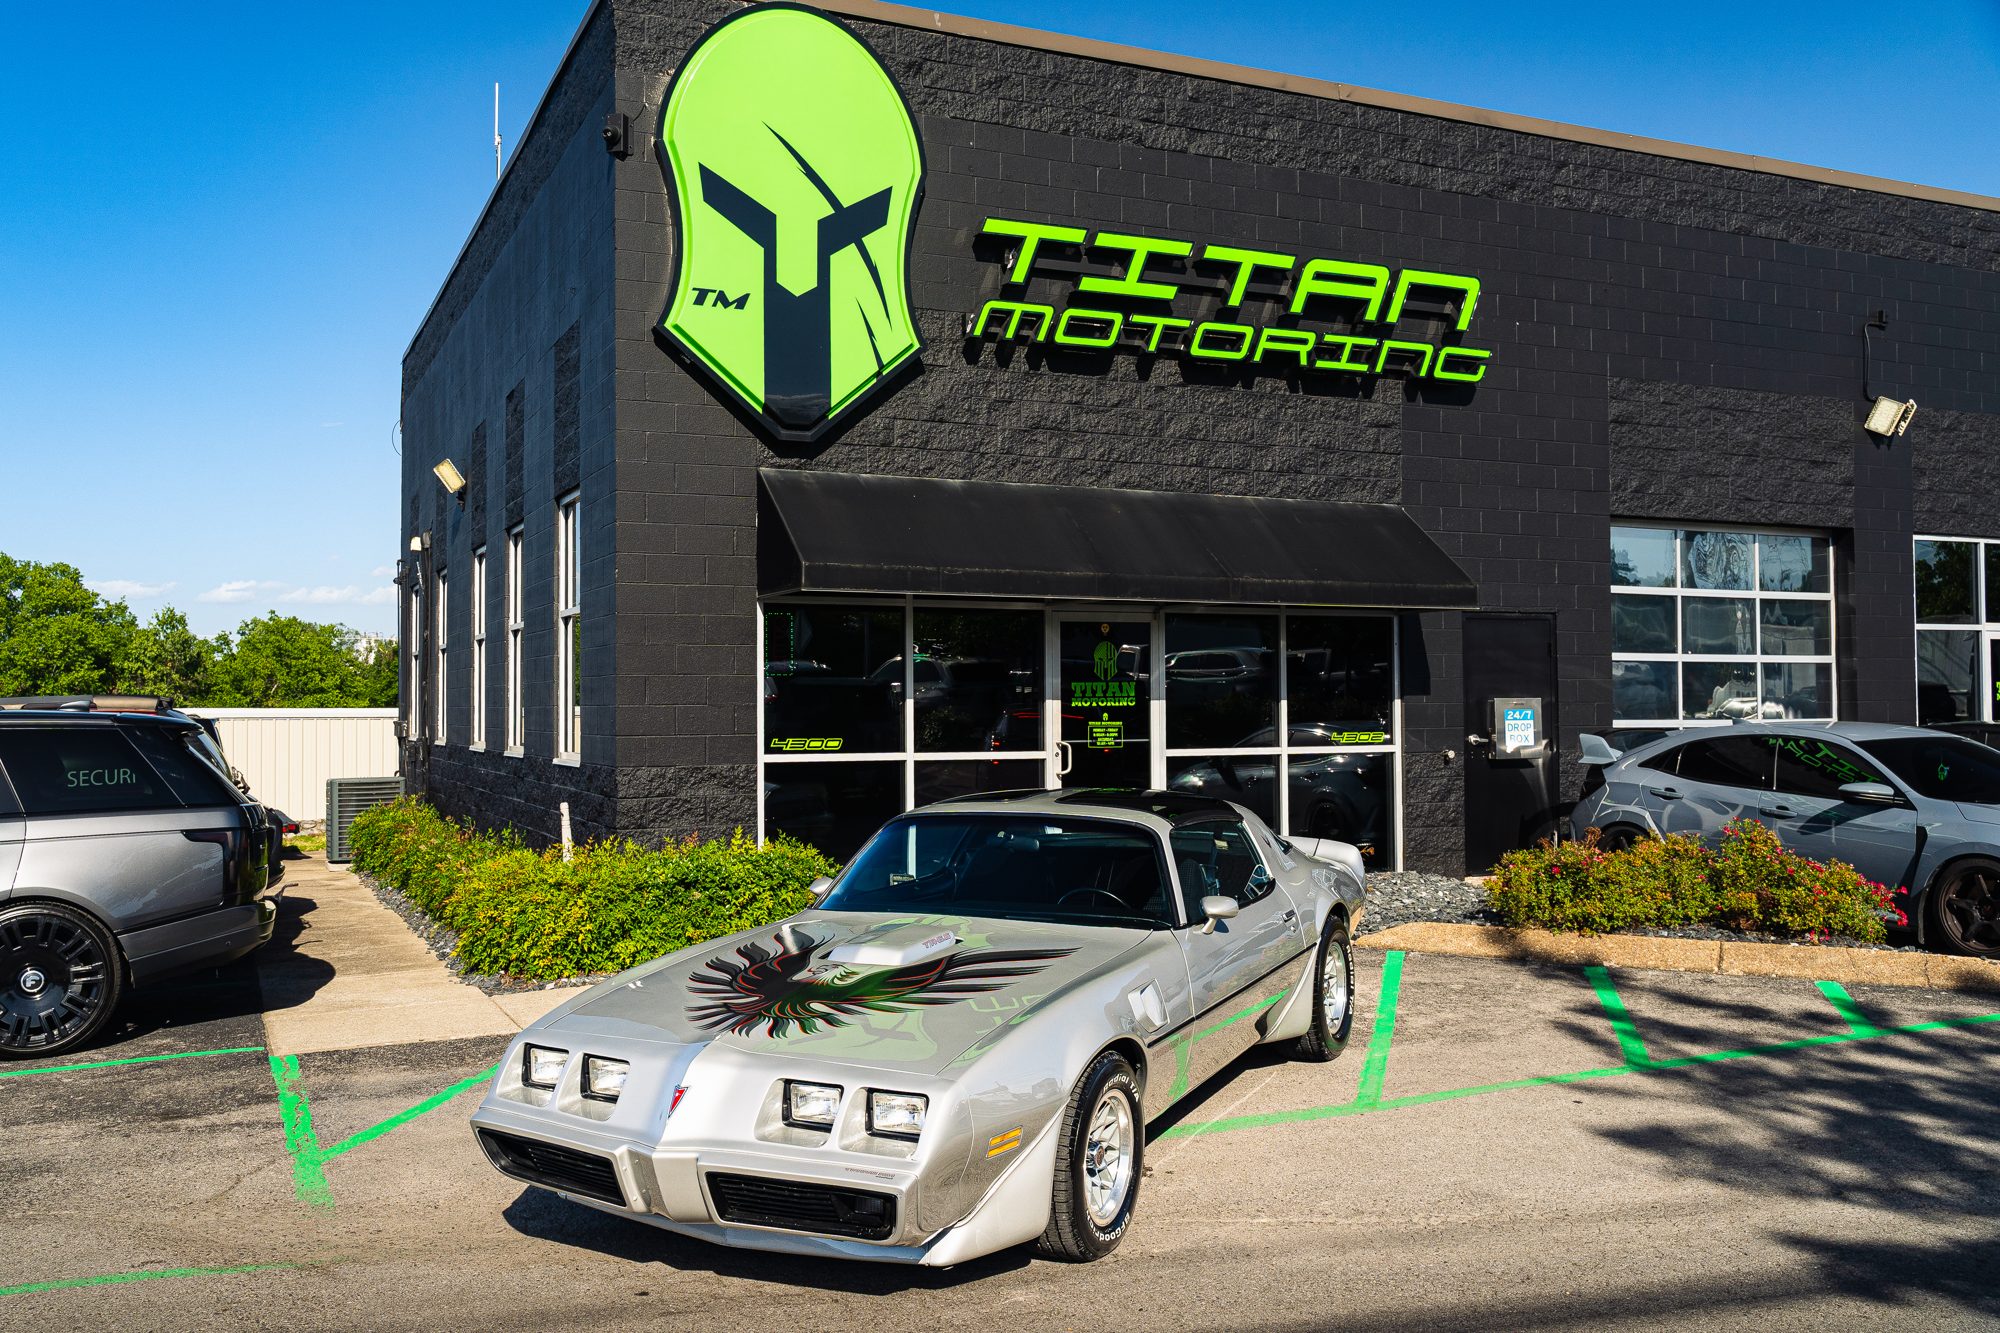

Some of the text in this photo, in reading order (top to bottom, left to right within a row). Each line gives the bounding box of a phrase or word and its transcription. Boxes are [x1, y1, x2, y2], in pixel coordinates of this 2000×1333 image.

[982, 216, 1481, 331] TITAN
[692, 287, 751, 310] TM
[973, 299, 1491, 384] MOTORING
[1071, 681, 1136, 697] TITAN
[1071, 697, 1136, 707] MOTORING
[1507, 710, 1532, 720] 24/7
[1507, 723, 1532, 732] DROP
[769, 738, 843, 750] 4300
[1331, 731, 1385, 743] 4302
[1103, 1073, 1130, 1093] Radial
